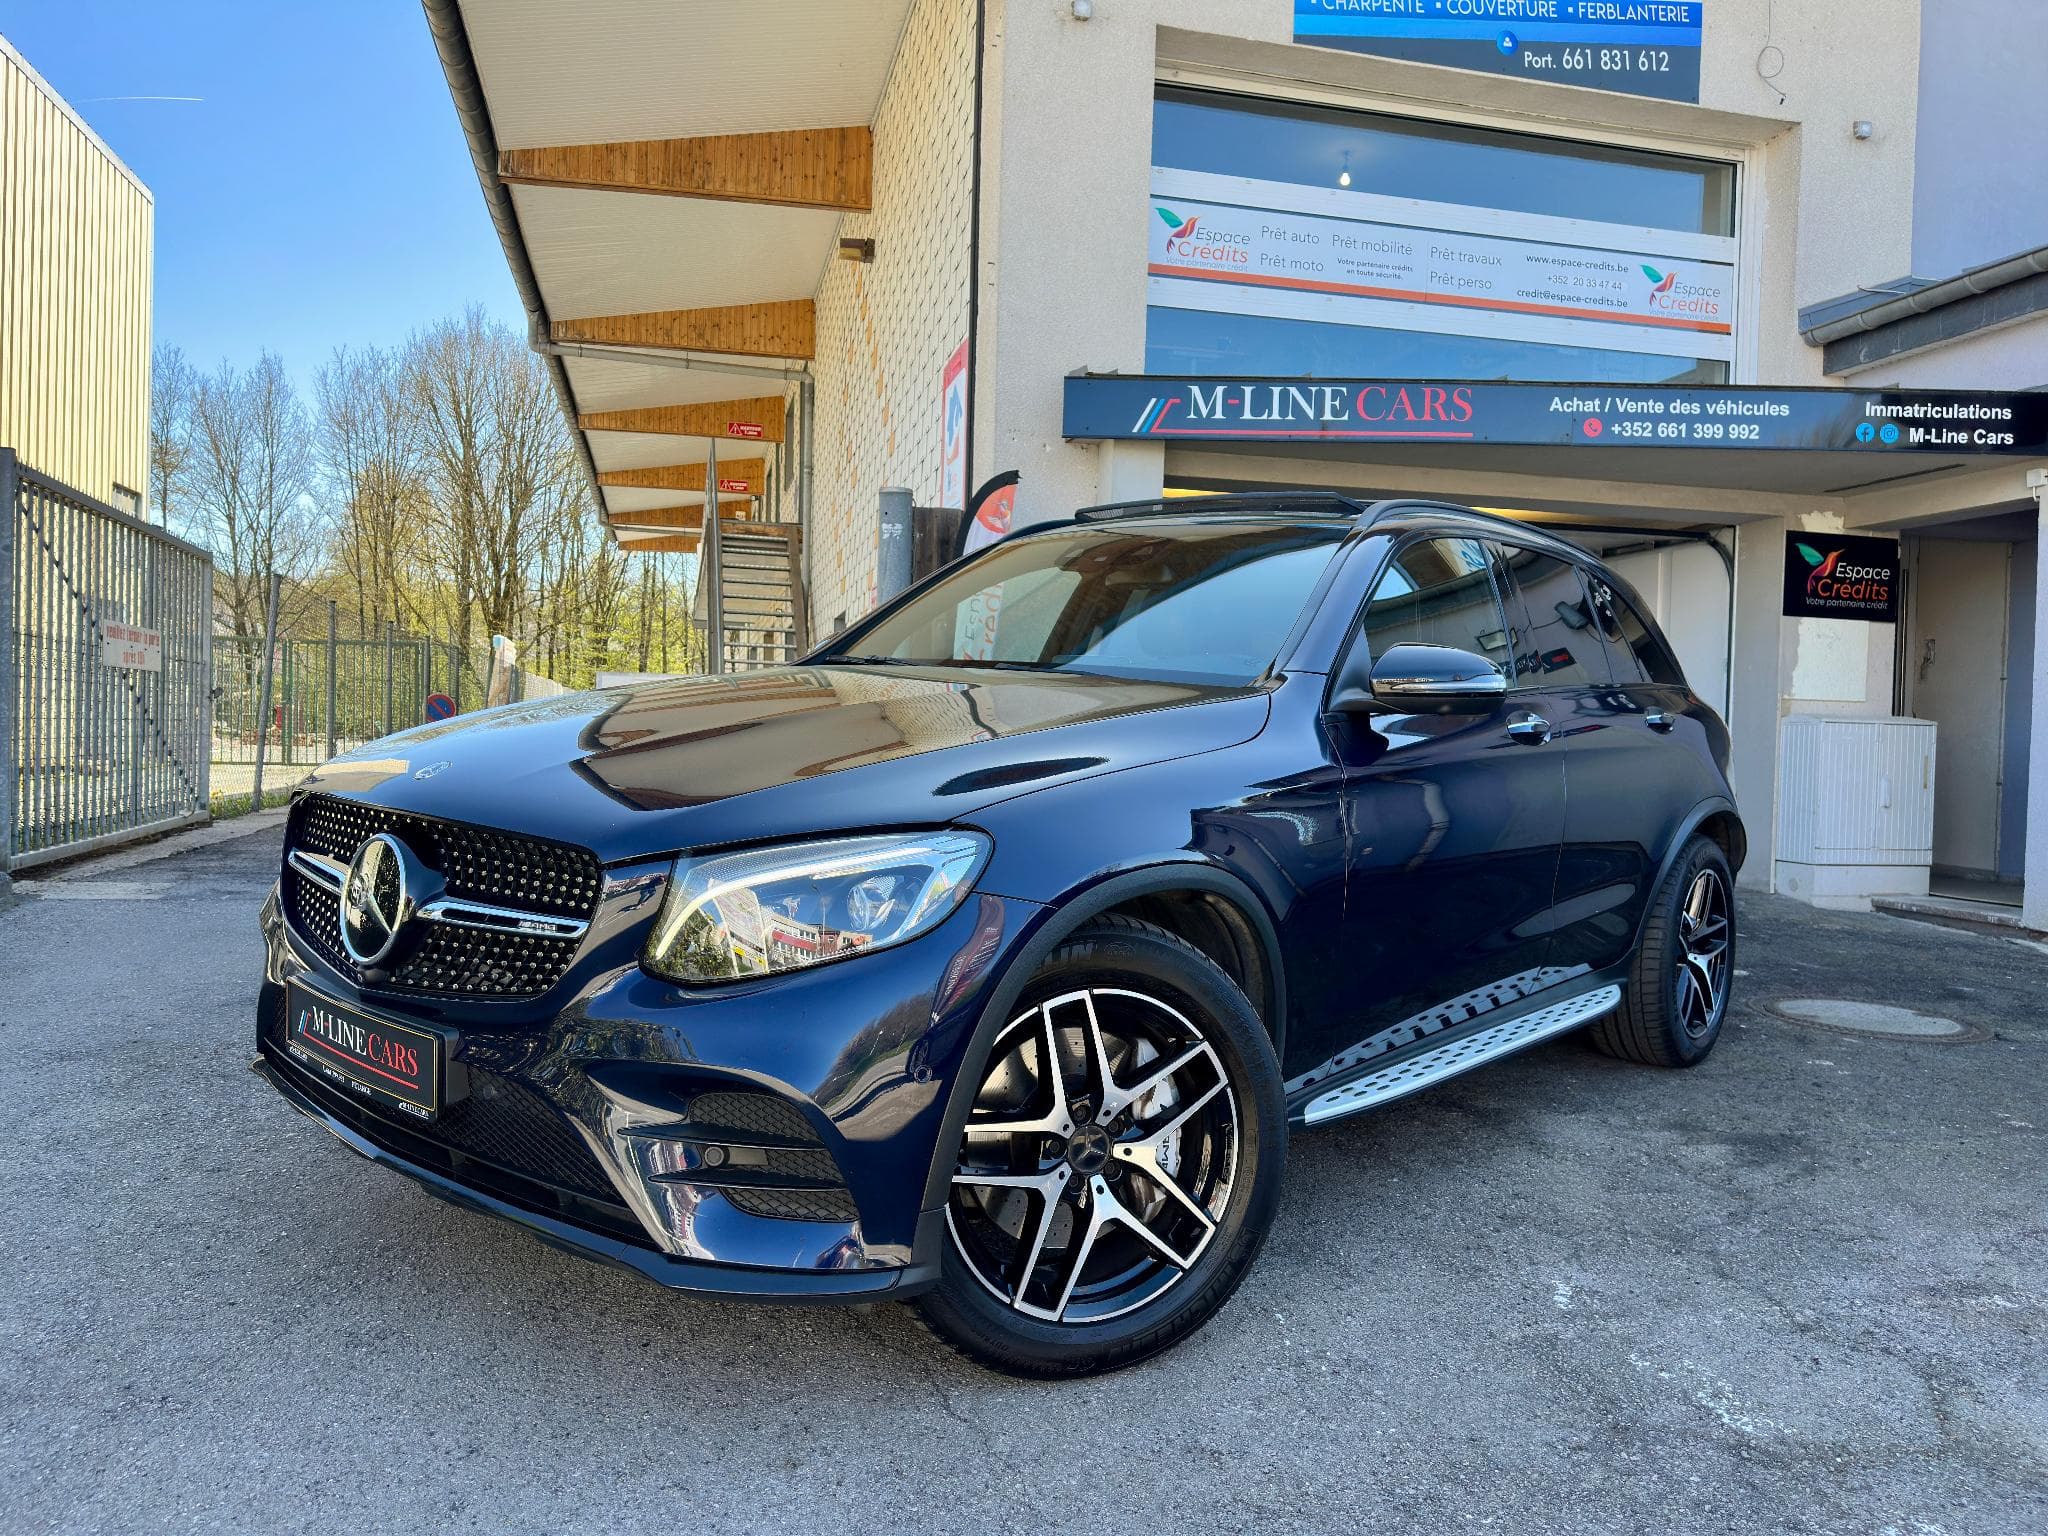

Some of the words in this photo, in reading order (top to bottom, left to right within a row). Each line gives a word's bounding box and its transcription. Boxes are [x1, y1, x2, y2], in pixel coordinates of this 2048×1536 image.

[1322, 0, 1424, 13] CHARPENTE
[1447, 0, 1557, 17] COUVERTURE
[1578, 2, 1690, 22] FERBLANTERIE
[1524, 51, 1557, 69] Port.
[1562, 48, 1592, 70] 661
[1600, 49, 1630, 71] 831
[1638, 50, 1670, 72] 612
[1196, 227, 1251, 245] Espace
[1261, 225, 1287, 241] Prêt
[1291, 232, 1320, 245] auto
[1178, 241, 1249, 263] Crédits
[1332, 234, 1357, 249] Prêt
[1361, 240, 1413, 256] mobilité
[1260, 252, 1287, 268] Prêt
[1290, 260, 1324, 272] moto
[1337, 257, 1355, 266] Votre
[1356, 260, 1391, 270] partenaire
[1430, 246, 1455, 261] Prêt
[1459, 250, 1502, 266] travaux
[1526, 255, 1629, 273] www.espace-credits.be
[1356, 269, 1375, 277] toute
[1430, 271, 1455, 286] Prêt
[1458, 277, 1492, 290] perso
[1573, 276, 1584, 287] 20
[1586, 278, 1597, 288] 33
[1516, 289, 1628, 308] credit@espace-credits.be
[1674, 281, 1721, 298] Espace
[1187, 385, 1349, 421] M-LINE
[1356, 386, 1473, 422] CARS
[1549, 396, 1601, 413] Achat
[1615, 397, 1665, 414] Vente
[1669, 399, 1701, 415] des
[1706, 400, 1790, 417] véhicules
[1865, 401, 2013, 420] Immatriculations
[1611, 421, 1653, 438] +352
[1657, 422, 1687, 438] 661
[1693, 423, 1724, 440] 399
[1728, 424, 1760, 440] 992
[1909, 427, 1969, 444] M-Line
[1973, 428, 2015, 445] Cars
[1836, 562, 1891, 581] Espace
[1817, 578, 1889, 601] Crédits
[367, 1033, 419, 1077] CARS
